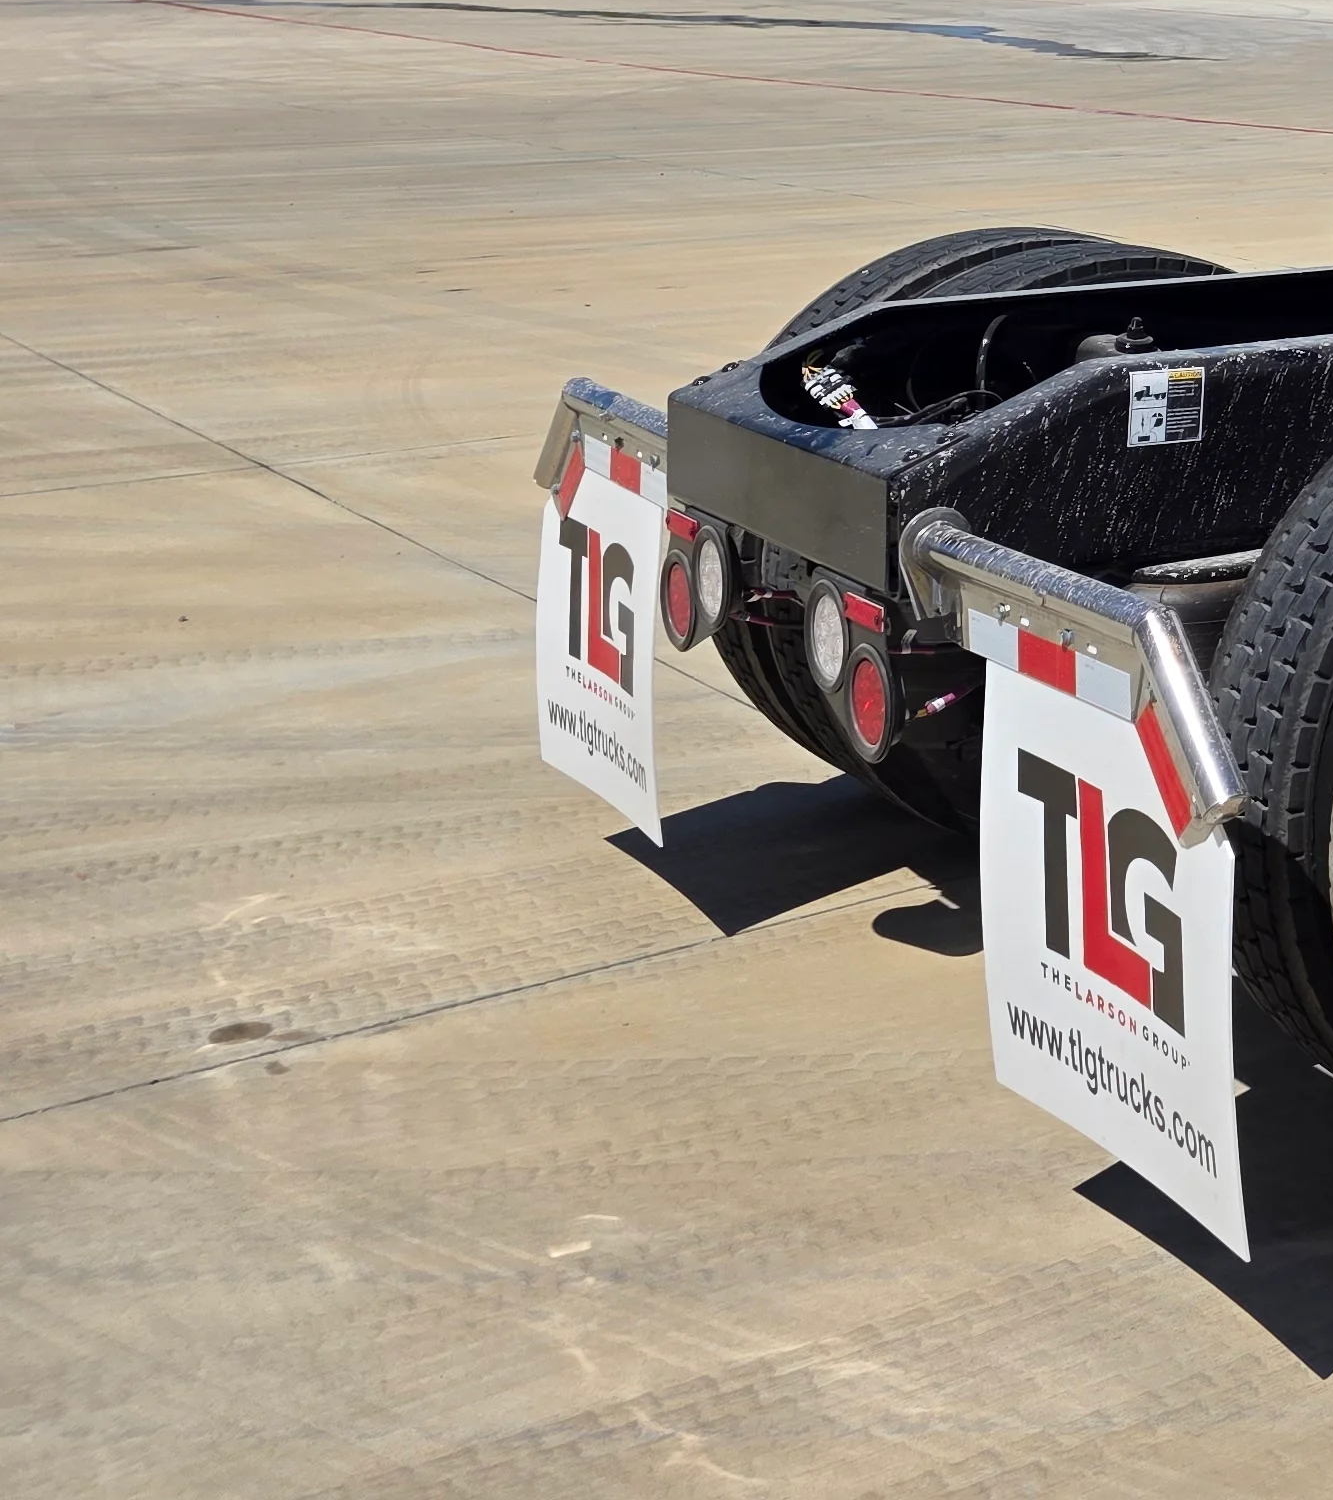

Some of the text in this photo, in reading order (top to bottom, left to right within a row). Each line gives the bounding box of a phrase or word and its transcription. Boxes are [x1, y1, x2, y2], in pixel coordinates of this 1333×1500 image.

[558, 516, 636, 698] TLG
[547, 698, 647, 794] www.tlgtrucks.com
[1017, 746, 1186, 1039] TLG
[1006, 1000, 1218, 1179] www.tlgtrucks.com
[1142, 1024, 1188, 1071] GROUP
